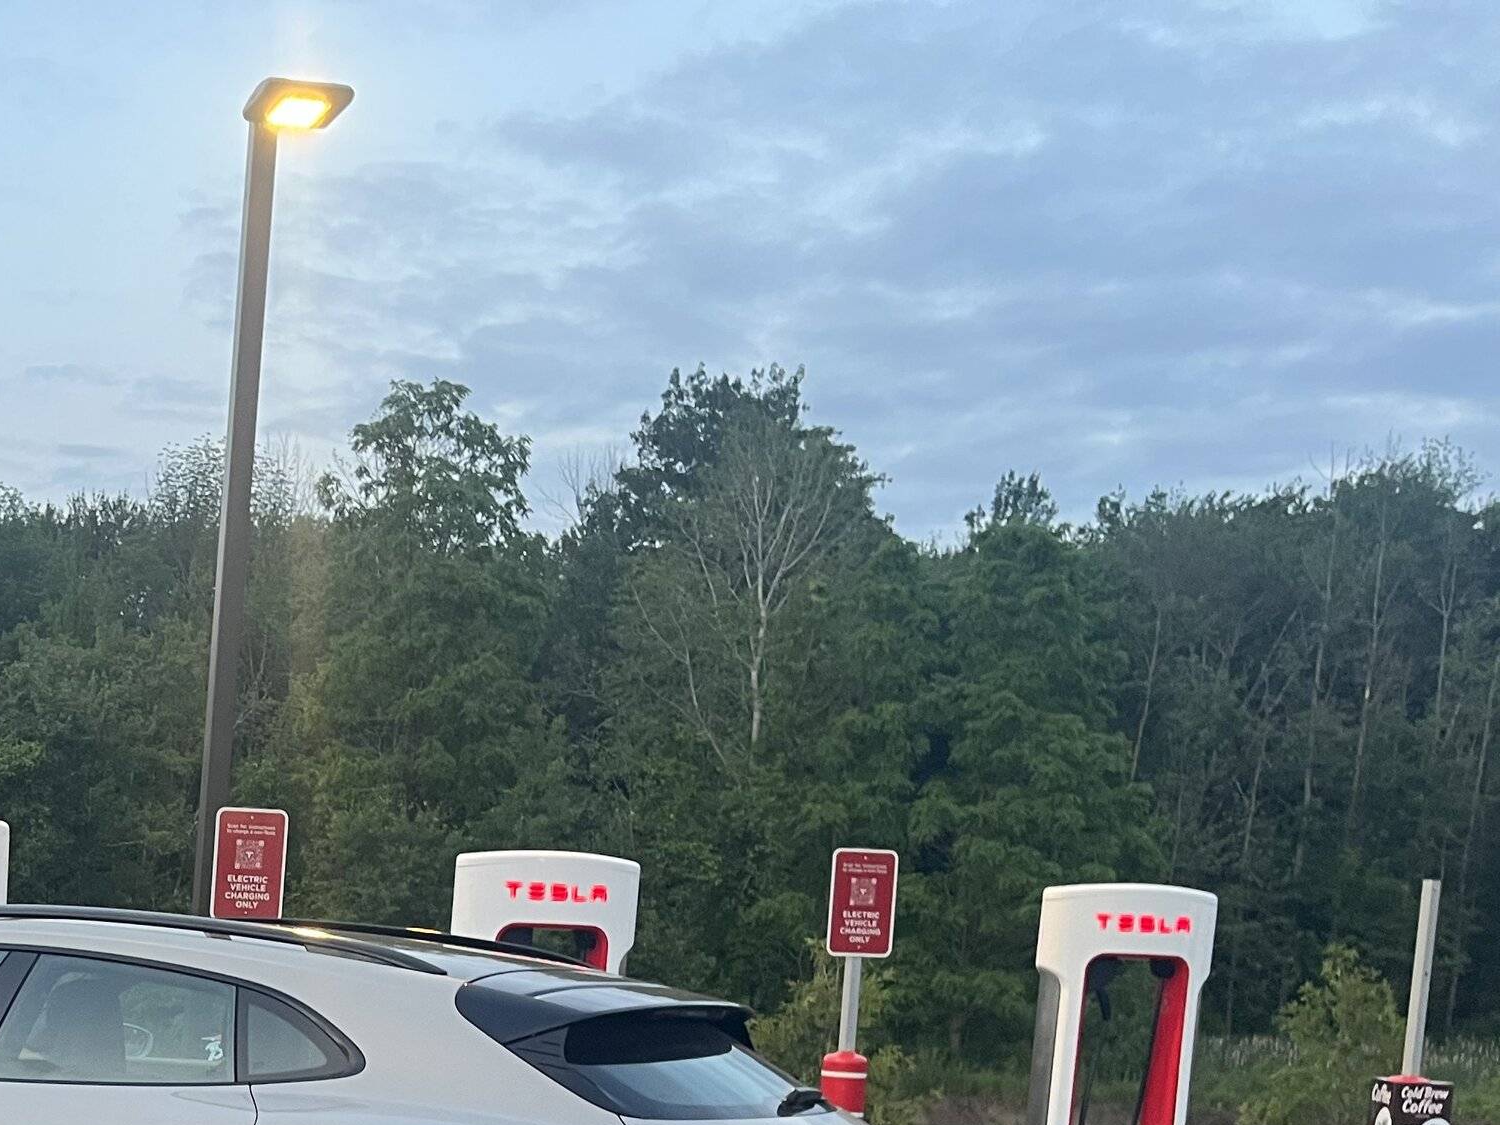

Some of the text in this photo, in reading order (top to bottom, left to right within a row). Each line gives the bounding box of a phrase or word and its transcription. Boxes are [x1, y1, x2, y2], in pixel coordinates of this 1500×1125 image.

[227, 874, 268, 884] ELECTRIC
[230, 884, 266, 892] VEHICLE
[506, 880, 608, 903] TESLA
[224, 892, 270, 900] CHARGING
[236, 901, 258, 909] ONLY
[842, 910, 880, 920] ELECTRIC
[844, 920, 877, 928] VEHICLE
[1096, 912, 1191, 934] TESLA
[840, 927, 880, 936] CHARGING
[849, 936, 870, 944] ONLY
[1401, 1086, 1449, 1100] Cold Brew
[1402, 1098, 1443, 1114] Coffee
